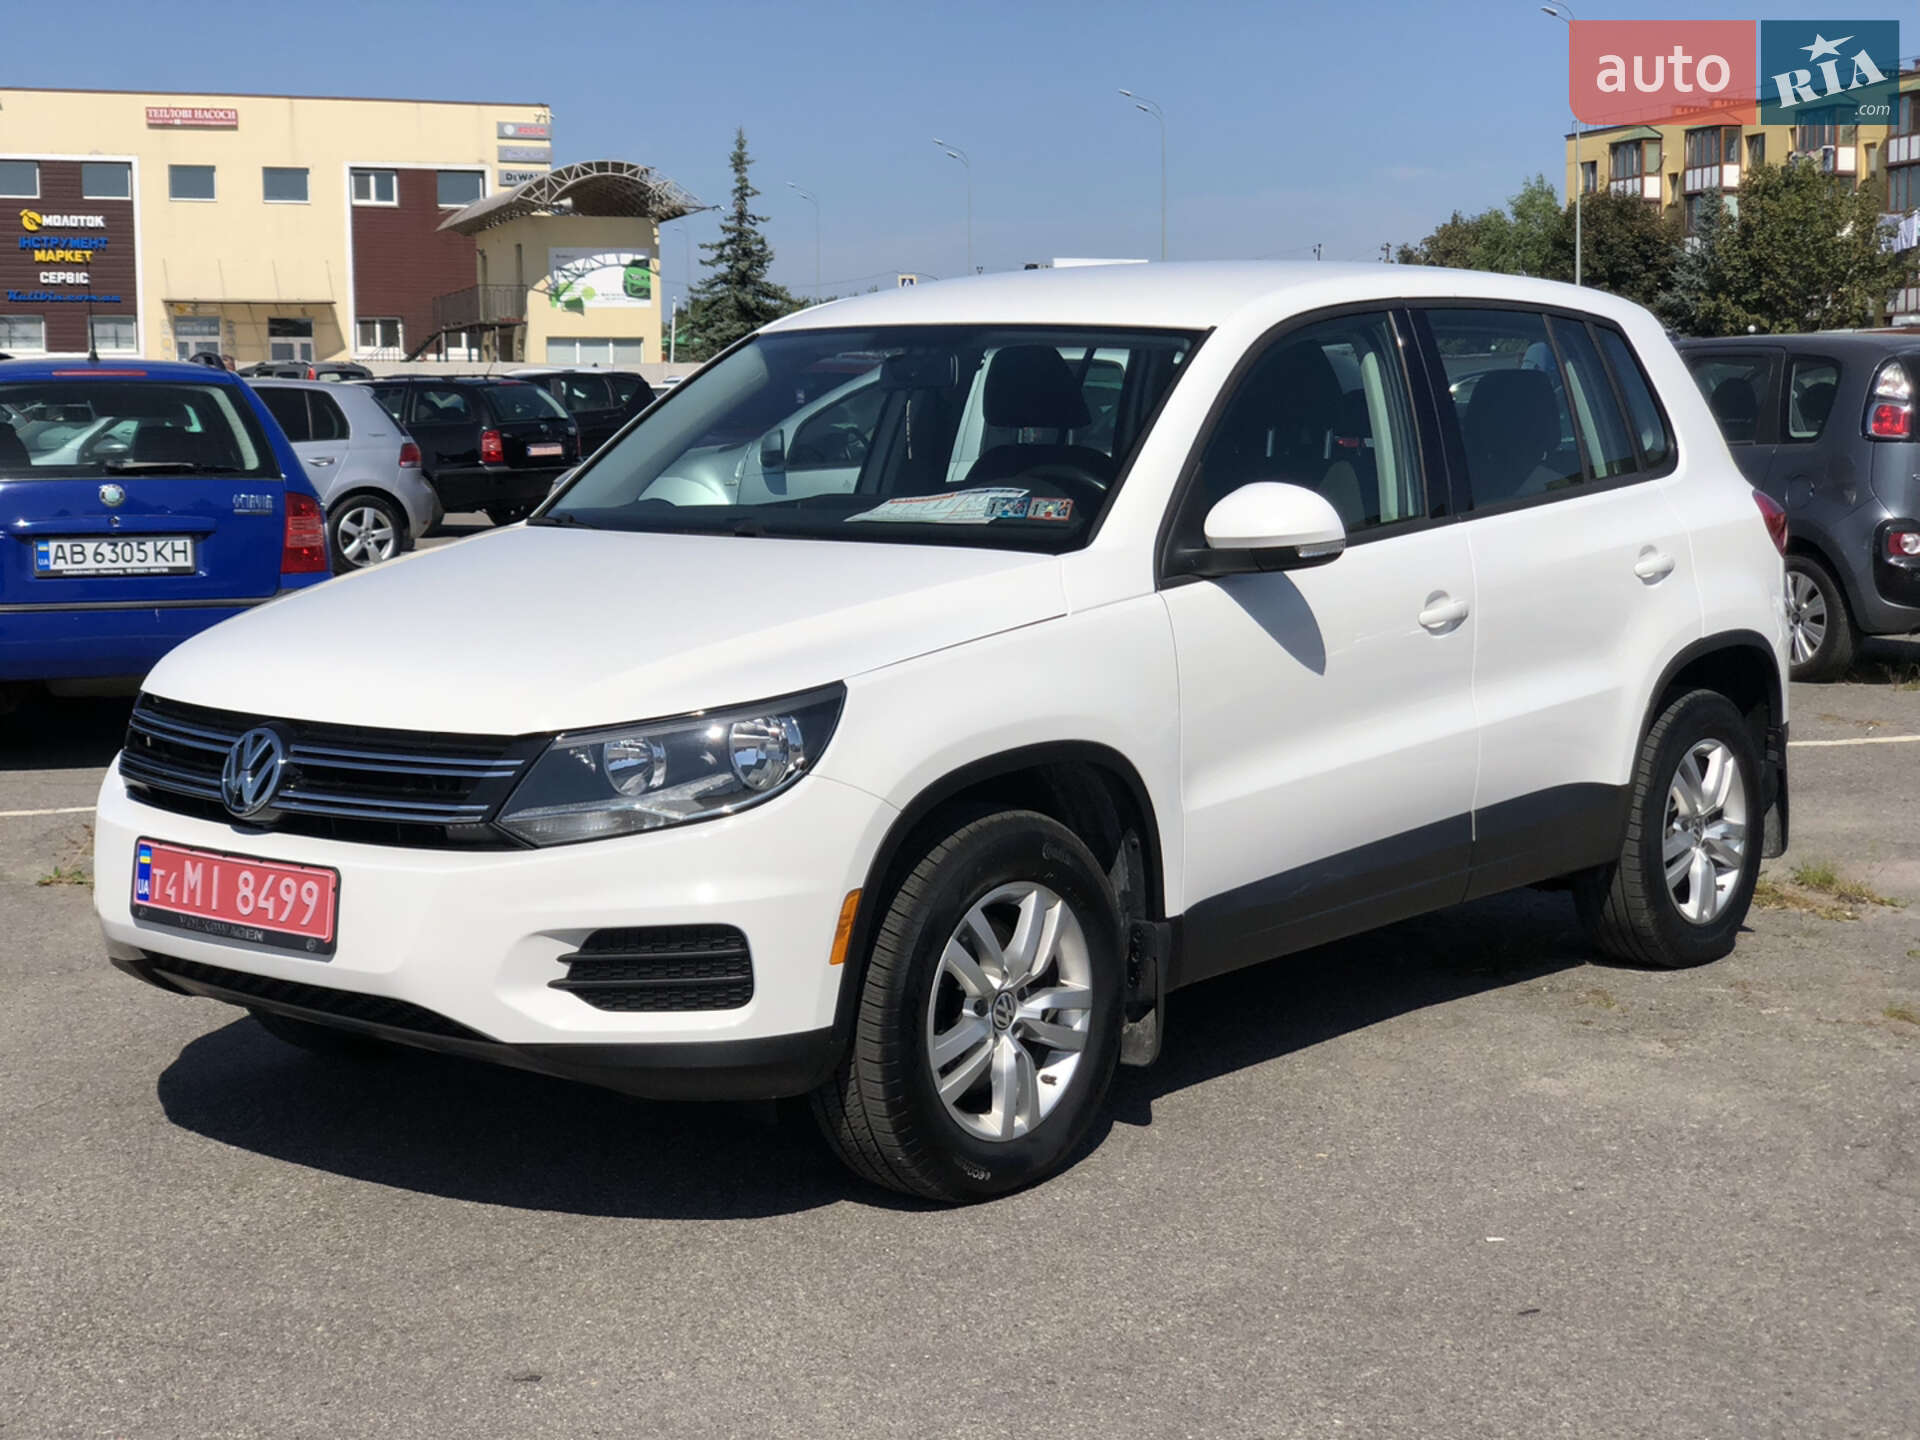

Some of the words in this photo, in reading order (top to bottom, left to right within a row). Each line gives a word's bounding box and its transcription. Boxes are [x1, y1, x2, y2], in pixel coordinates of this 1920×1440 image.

[42, 214, 105, 228] МОЛОТОК
[34, 249, 93, 262] МАРКЕТ
[40, 271, 89, 284] СЕРВІС
[52, 543, 87, 566] AB
[92, 541, 148, 564] 6305
[154, 541, 188, 563] KH
[137, 878, 150, 895] UA
[236, 870, 320, 926] 8499
